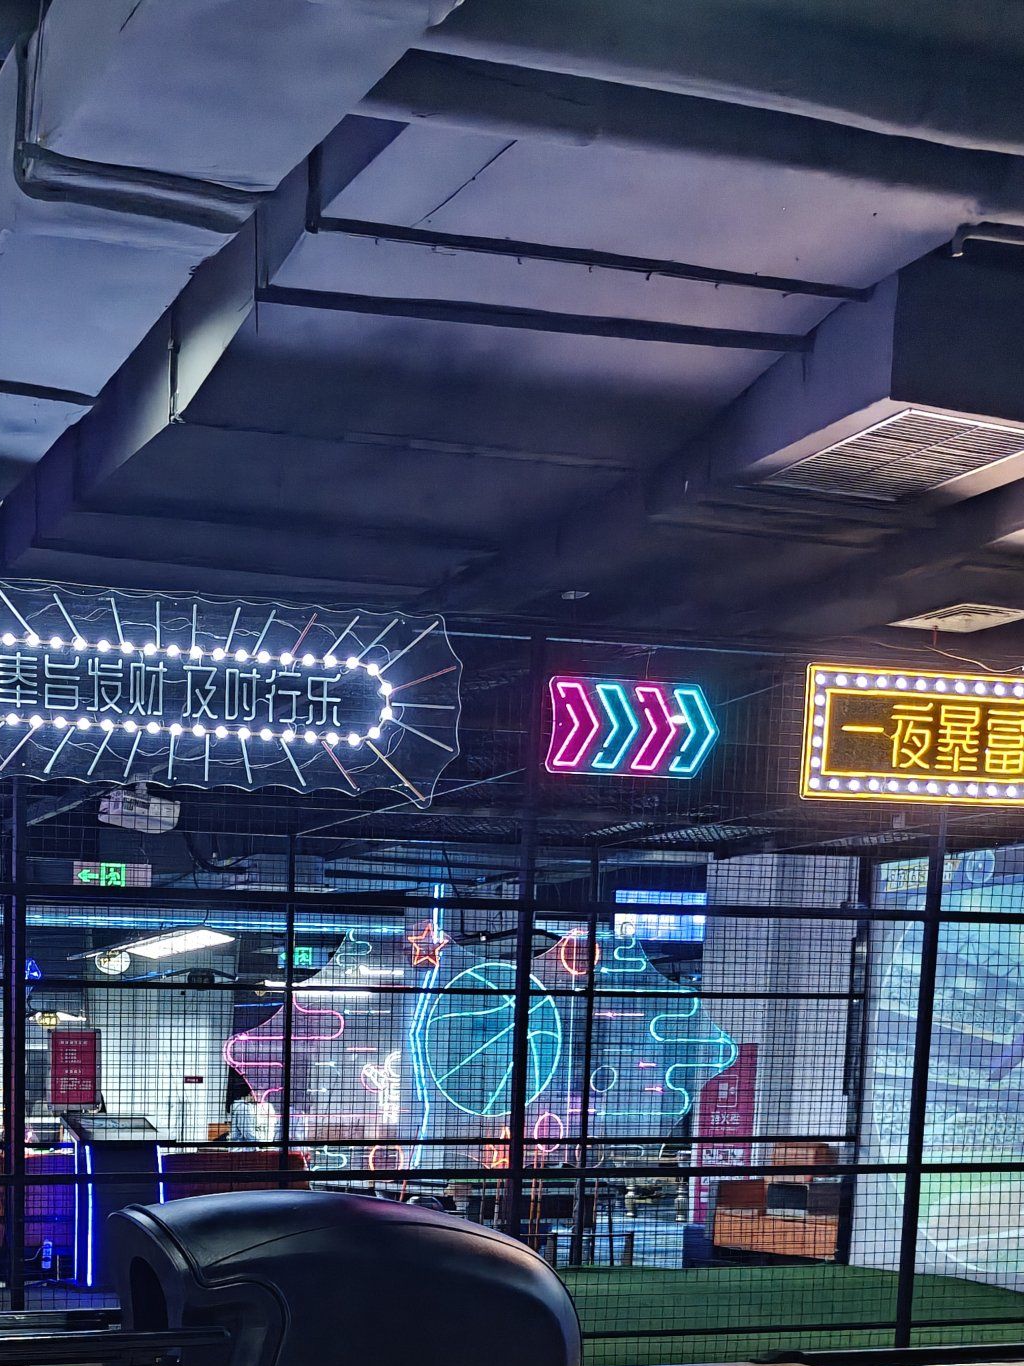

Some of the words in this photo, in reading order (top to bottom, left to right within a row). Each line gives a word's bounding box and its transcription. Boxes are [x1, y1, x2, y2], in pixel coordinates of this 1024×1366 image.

[182, 665, 342, 727] 及时行乐
[841, 702, 1024, 774] 一夜暴富
